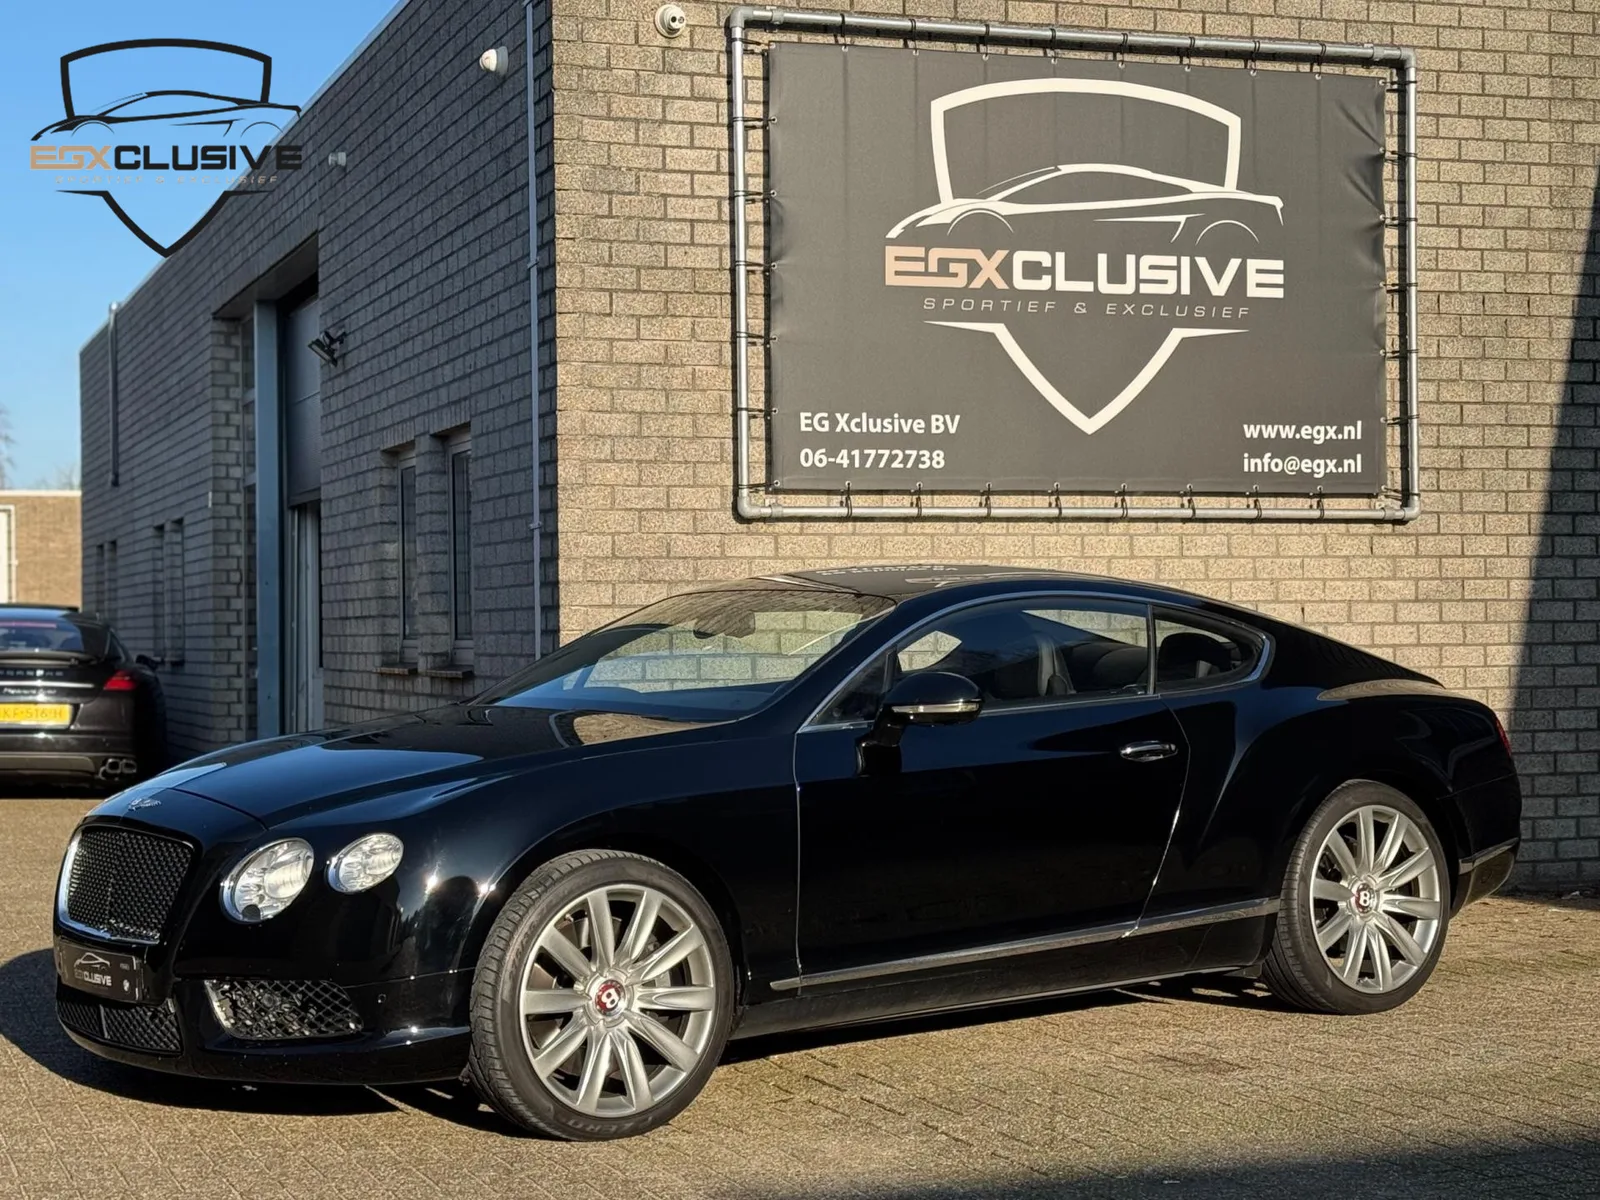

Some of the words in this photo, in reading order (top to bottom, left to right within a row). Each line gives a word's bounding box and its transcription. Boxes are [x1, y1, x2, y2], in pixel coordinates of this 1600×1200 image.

[885, 245, 1284, 298] EGXCLUSIVE
[923, 297, 1056, 314] SPORTIEF
[1074, 302, 1088, 314] &
[1105, 303, 1250, 319] EXCLUSIEF
[800, 412, 830, 433] EG
[834, 412, 926, 434] Xclusive
[930, 413, 961, 434] BV
[1243, 420, 1362, 445] www.egx.nl
[799, 448, 946, 469] 06-41772738
[1243, 452, 1362, 478] info@egx.nl
